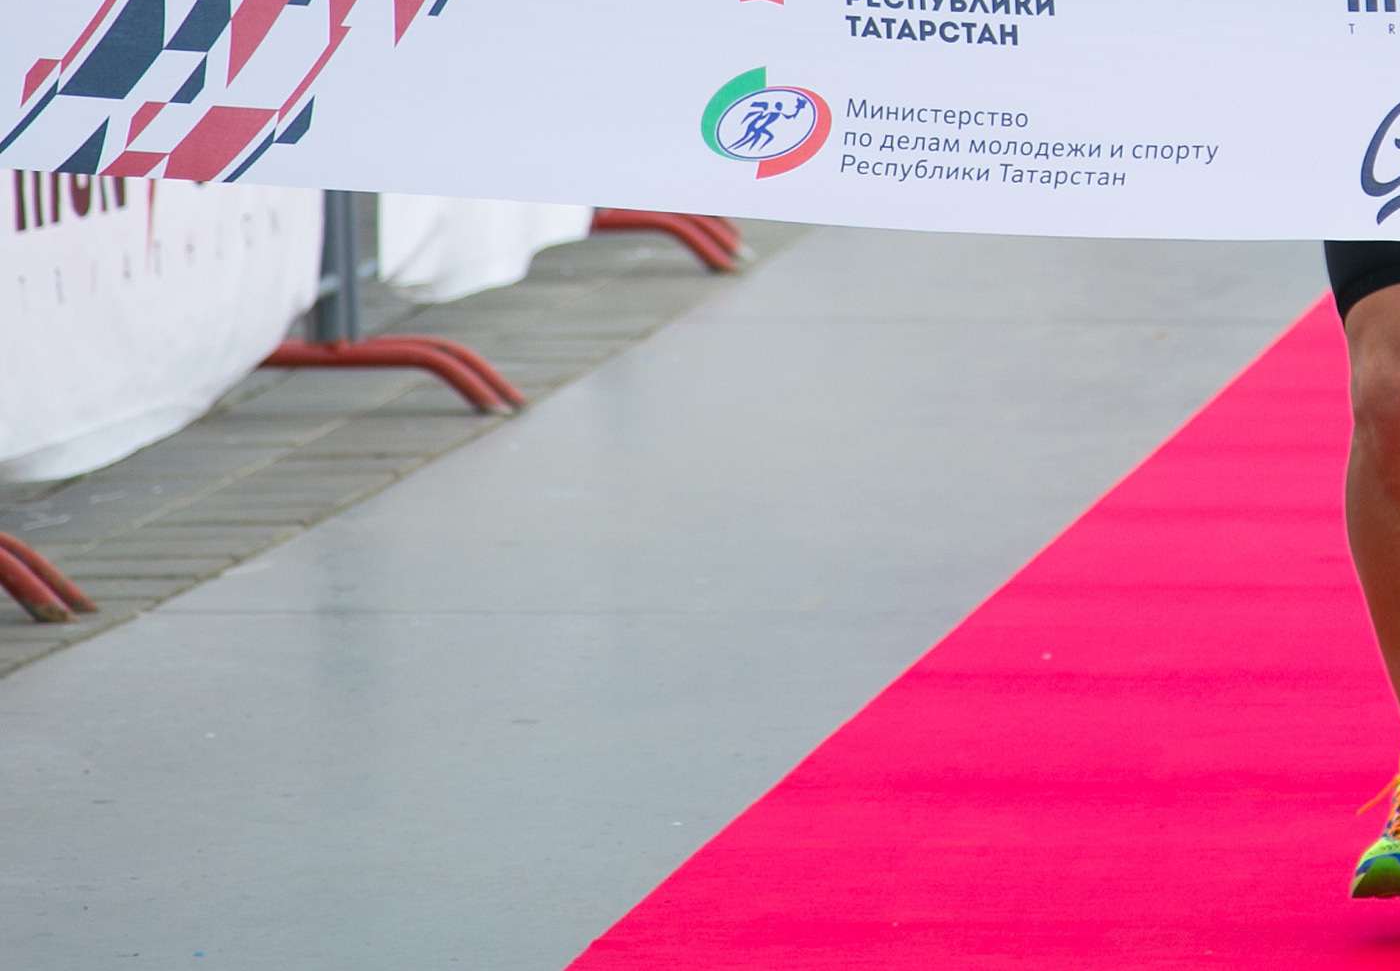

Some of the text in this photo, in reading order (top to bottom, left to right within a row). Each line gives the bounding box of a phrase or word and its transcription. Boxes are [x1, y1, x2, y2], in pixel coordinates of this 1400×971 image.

[845, 15, 1019, 46] ТАТАРСТАН
[845, 98, 1029, 129] Министерство
[843, 130, 1219, 165] по делам молодежи и спорту
[840, 154, 1126, 189] Республики Татарстан
